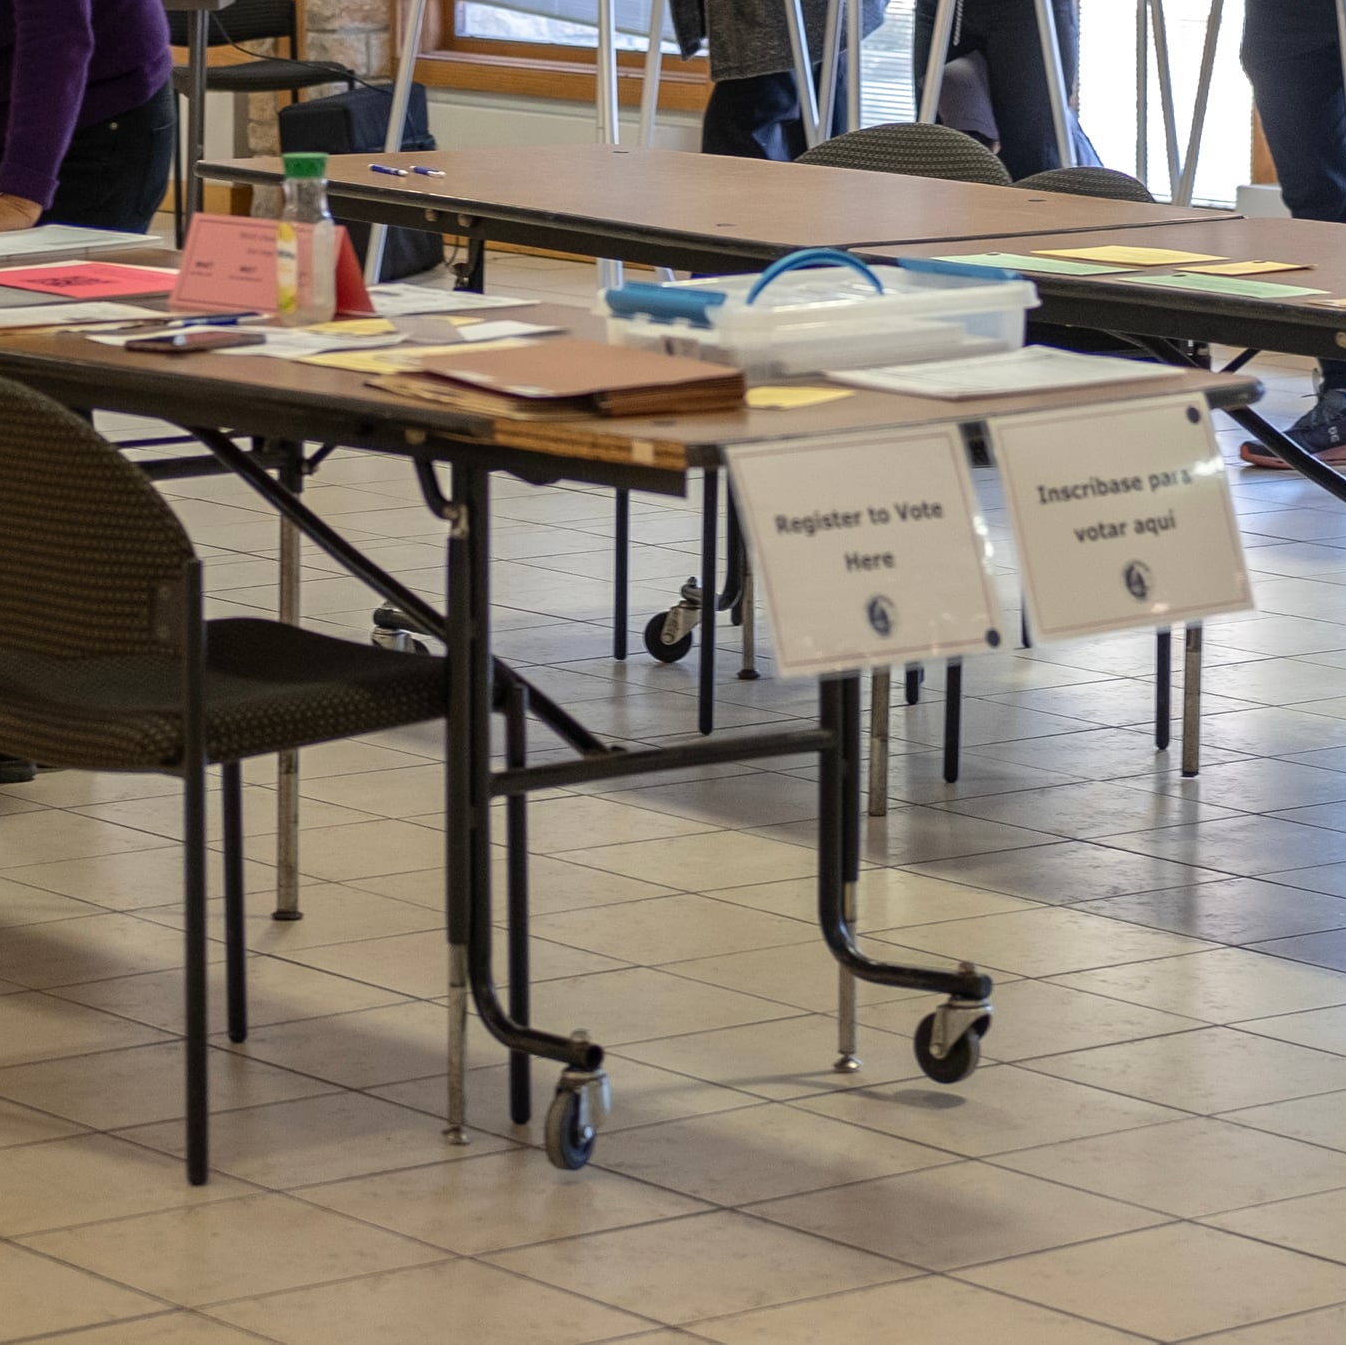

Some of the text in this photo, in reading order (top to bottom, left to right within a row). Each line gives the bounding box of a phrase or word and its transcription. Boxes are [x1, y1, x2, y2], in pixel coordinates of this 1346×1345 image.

[775, 502, 943, 537] Register to Vote
[1074, 523, 1126, 543] votar
[845, 552, 895, 571] Here
